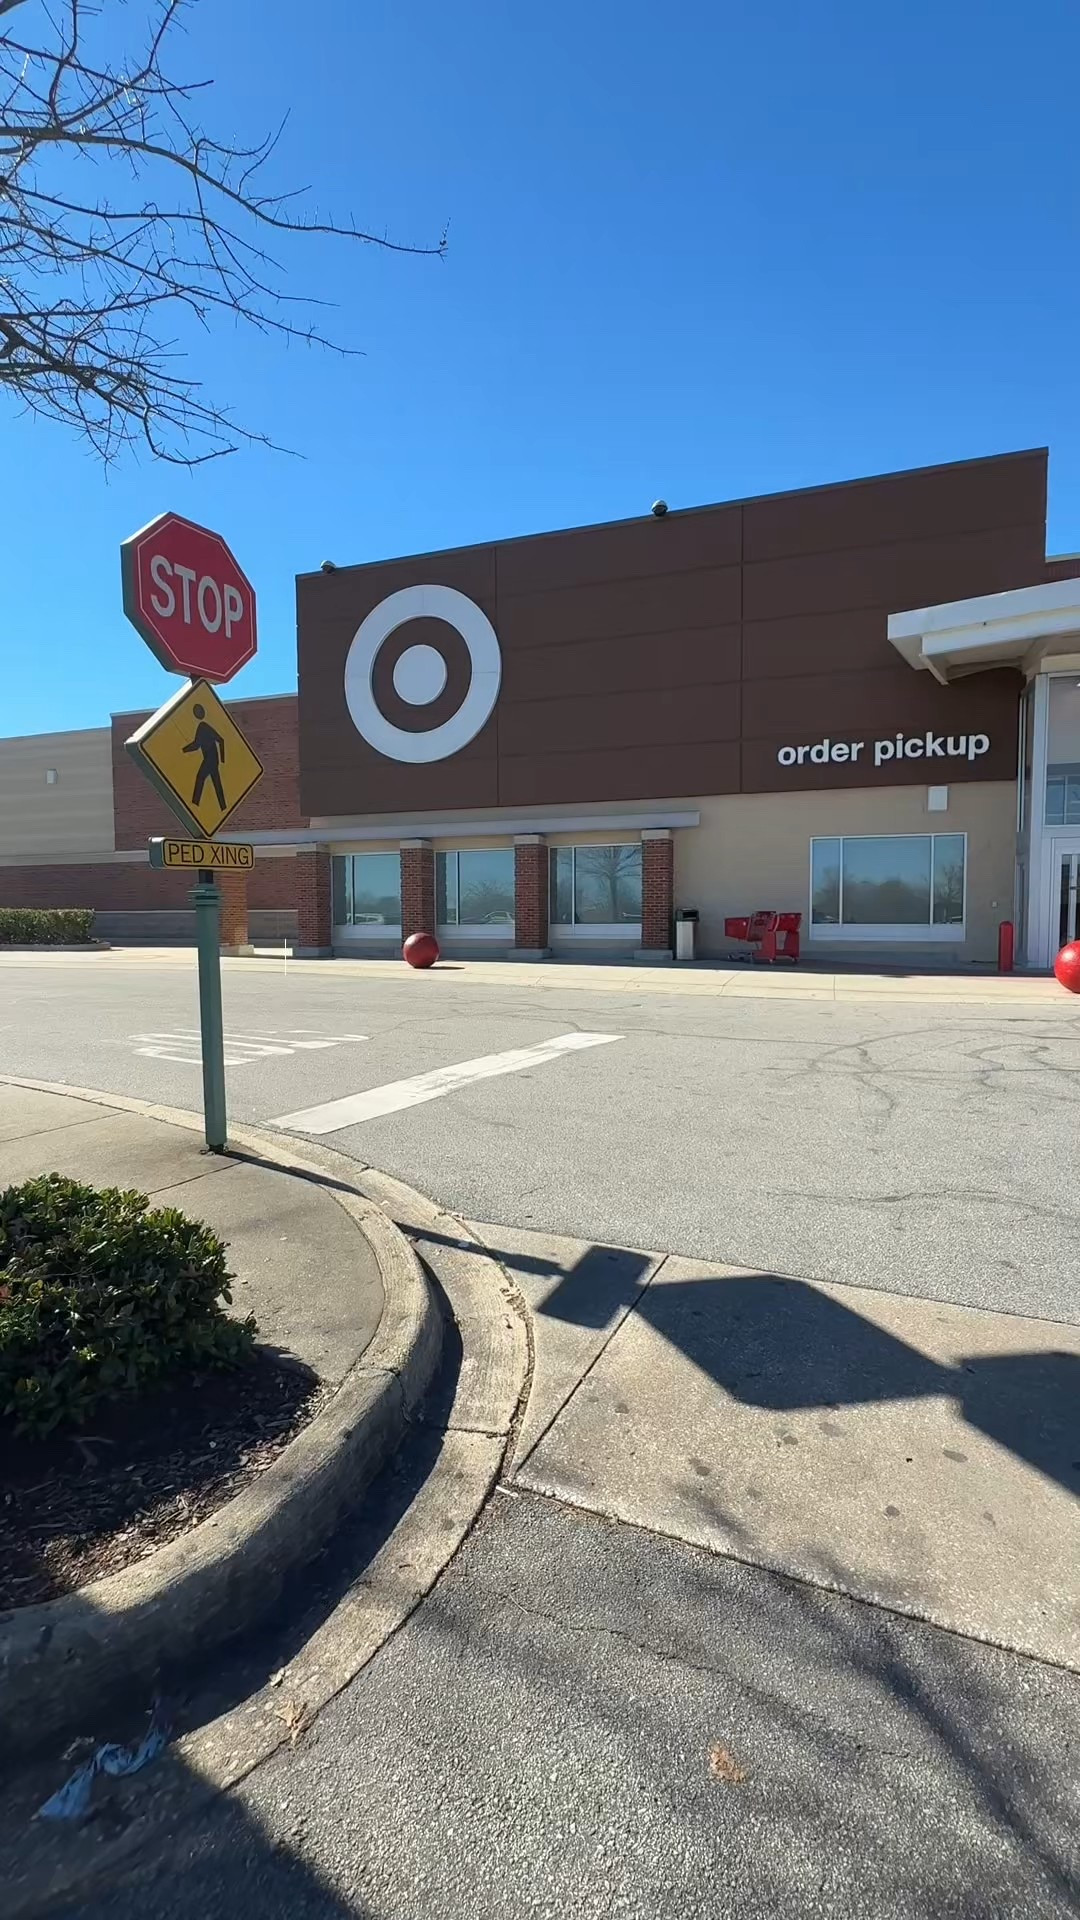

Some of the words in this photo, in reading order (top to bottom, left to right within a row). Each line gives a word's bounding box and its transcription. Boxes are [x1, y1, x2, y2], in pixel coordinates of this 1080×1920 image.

[150, 554, 244, 639] STOP
[777, 738, 865, 766] order
[874, 731, 990, 767] pickup
[168, 843, 205, 863] PED
[210, 845, 249, 865] XING
